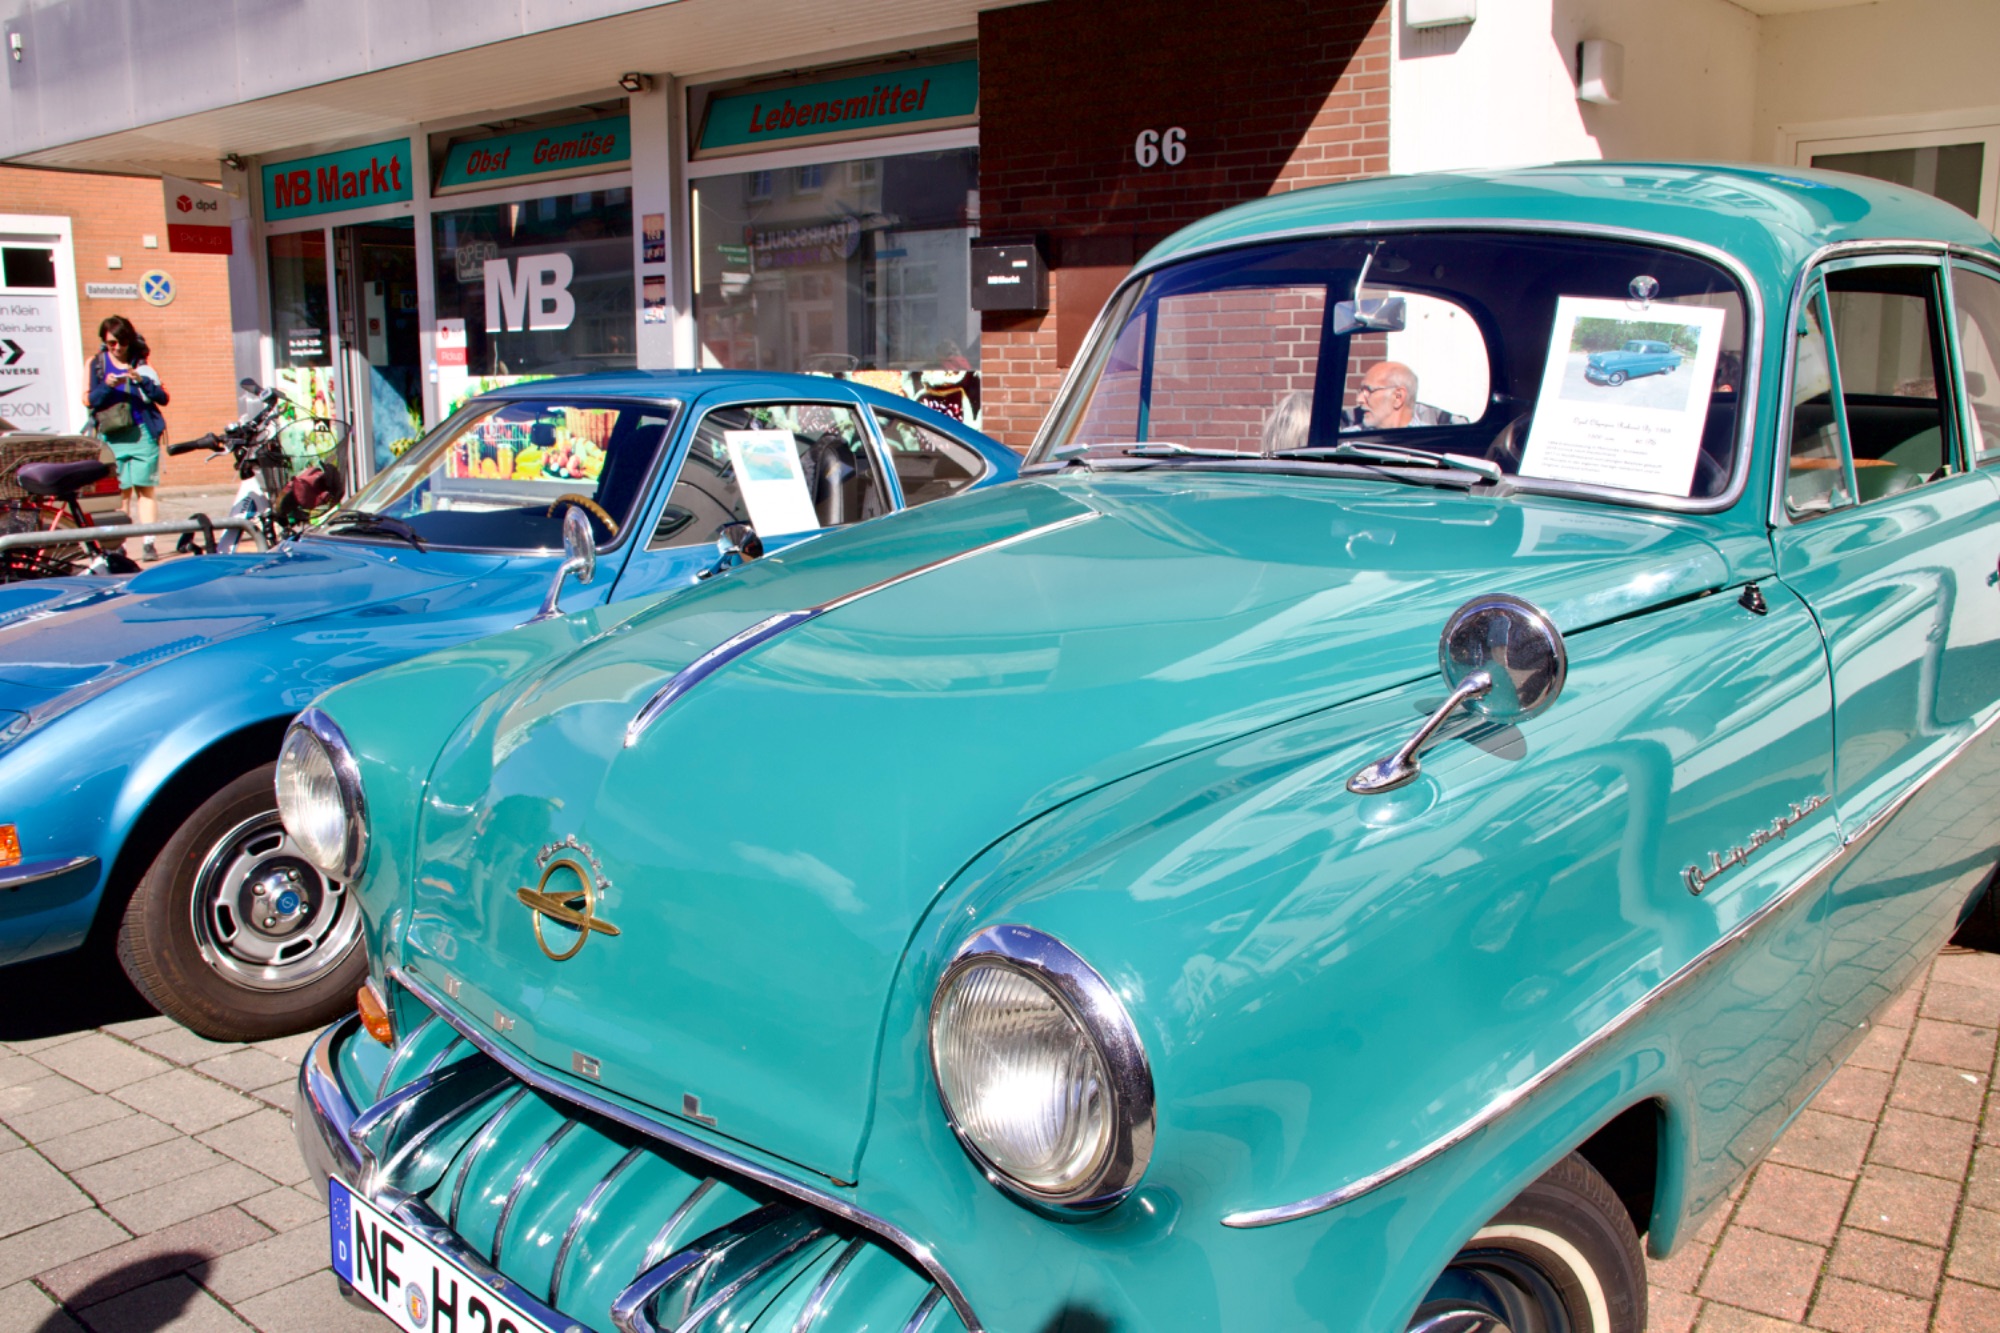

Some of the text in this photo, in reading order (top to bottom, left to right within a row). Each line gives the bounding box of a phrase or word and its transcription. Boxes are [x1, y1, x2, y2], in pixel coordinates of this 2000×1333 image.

[749, 80, 930, 133] Lebensmittel
[467, 132, 615, 175] Obst Gemüse
[1135, 127, 1187, 168] 66
[274, 155, 402, 209] MB Markt
[196, 199, 217, 212] dpd
[11, 305, 40, 316] Klein
[484, 252, 576, 333] MB
[22, 324, 53, 333] Jeans
[339, 1239, 348, 1262] D
[355, 1209, 405, 1303] NF
